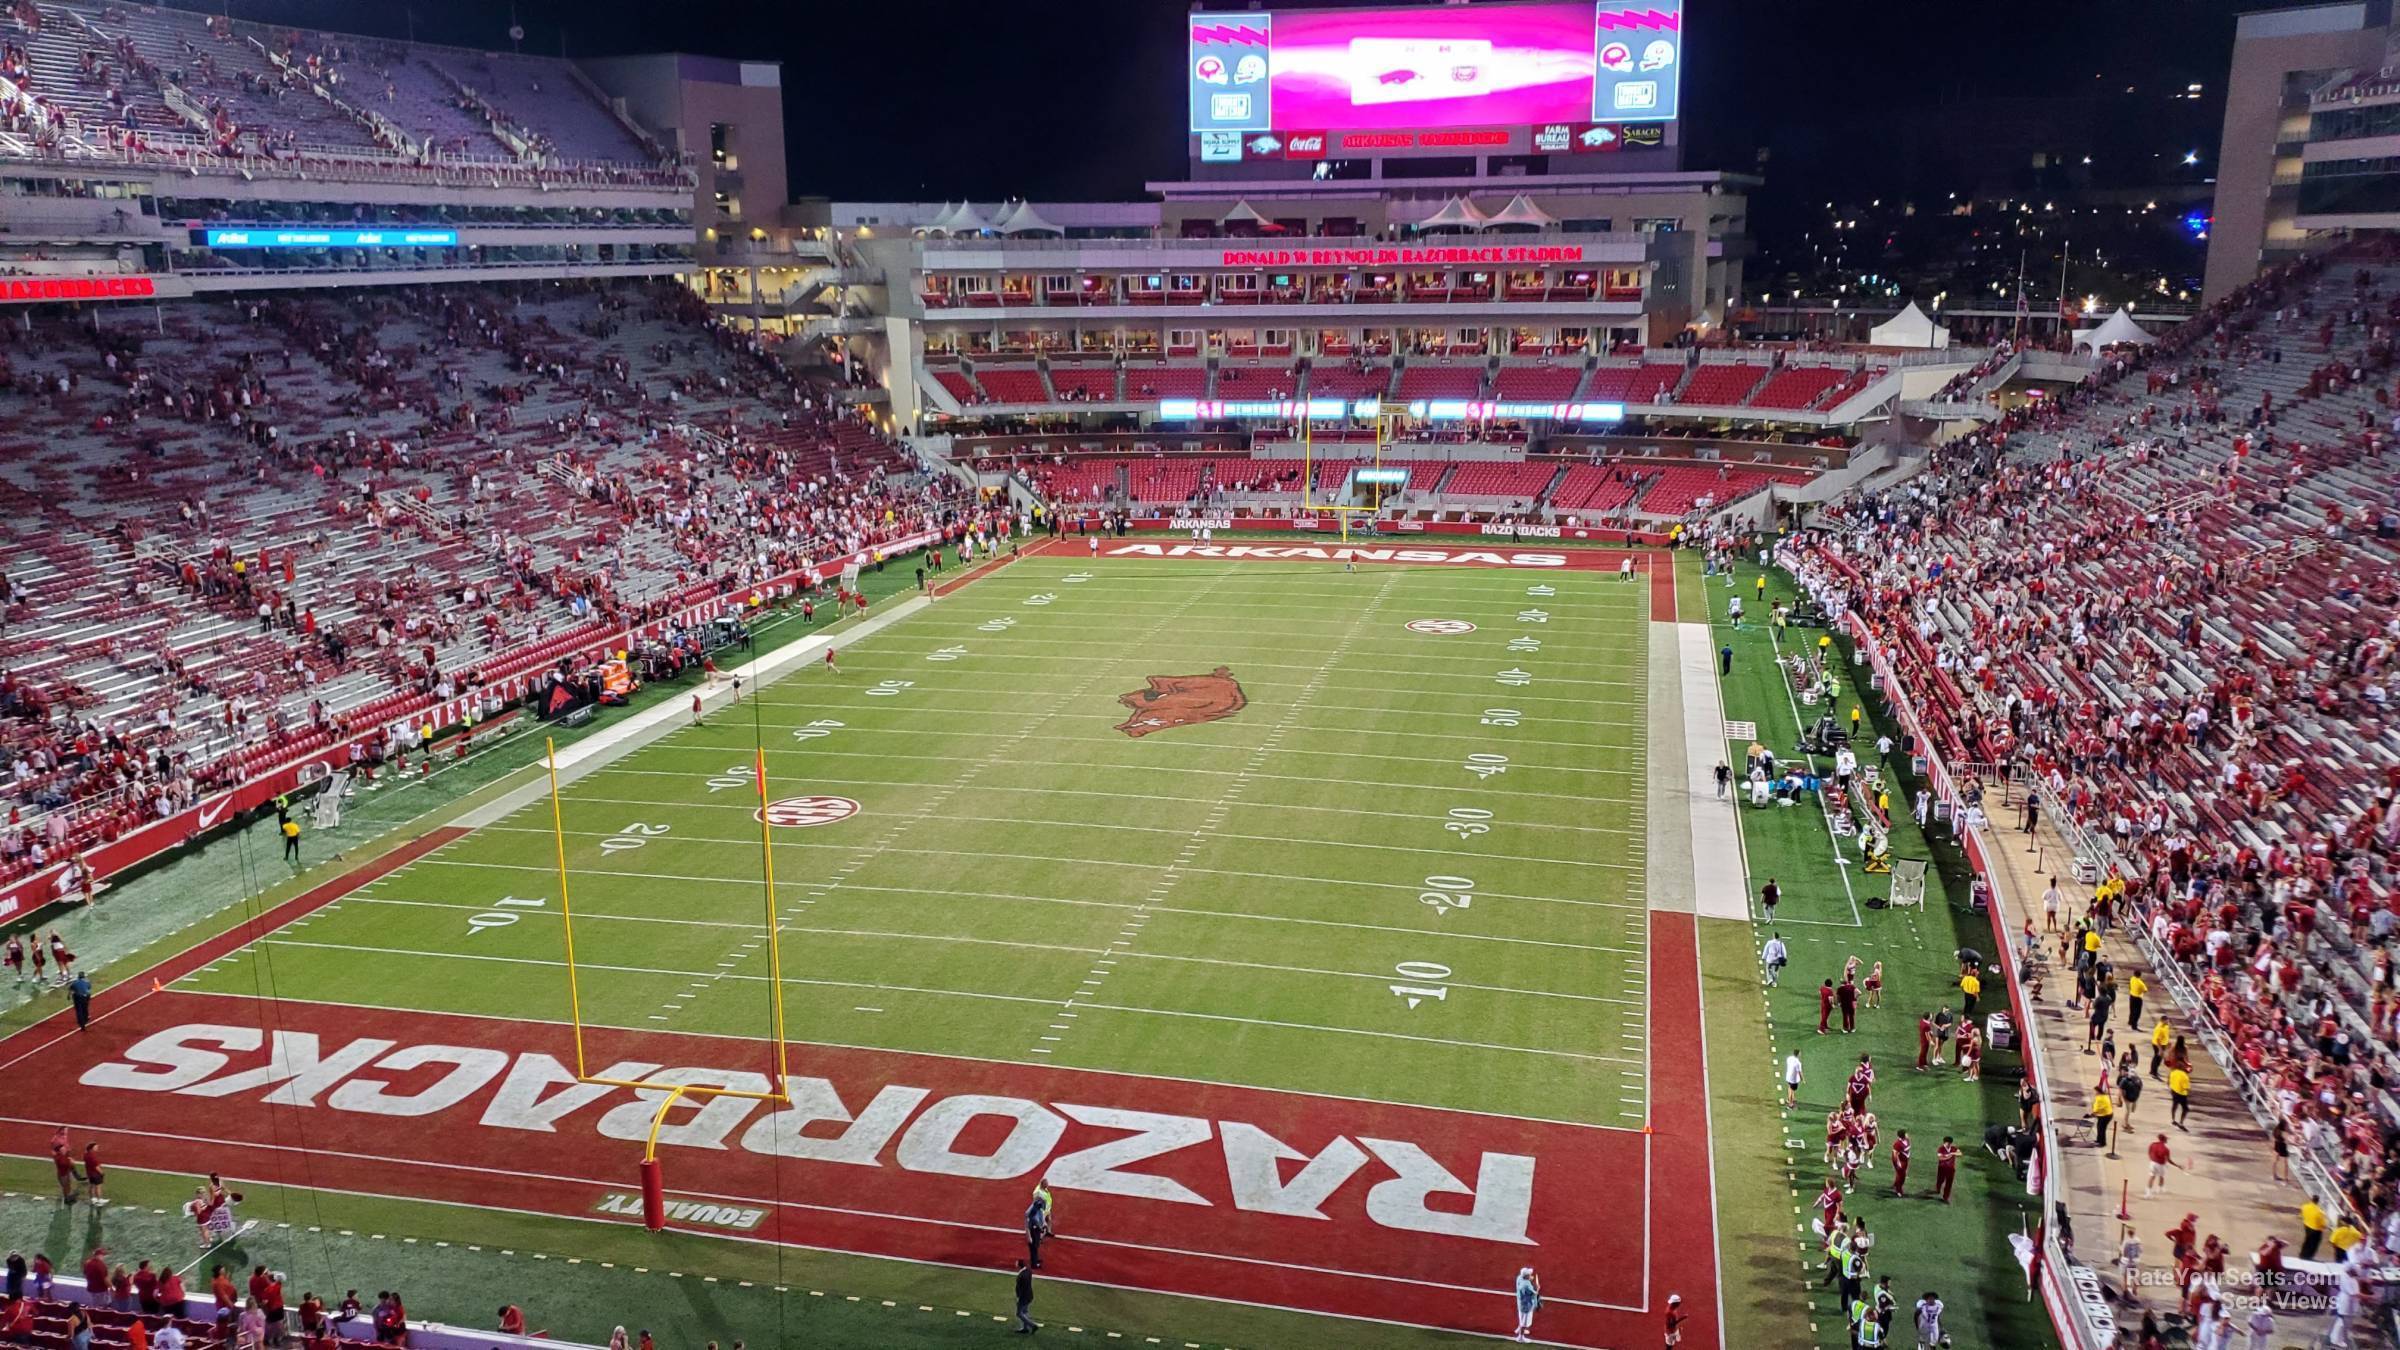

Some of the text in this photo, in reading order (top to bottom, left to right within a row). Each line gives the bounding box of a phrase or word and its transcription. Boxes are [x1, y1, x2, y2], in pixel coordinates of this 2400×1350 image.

[1536, 134, 1570, 144] BUREAU
[1545, 126, 1569, 134] FARM
[1343, 134, 1413, 147] ARKANSAS
[1224, 247, 1582, 265] DONALD W REYNOLDS RAZORBACK STADIUM
[1169, 519, 1231, 529] ARKANSAS
[1105, 544, 1567, 566] ARKANSAS
[1526, 586, 1556, 596] 10
[1516, 611, 1549, 623] 20
[1507, 638, 1541, 652] 30
[1496, 671, 1532, 686] 40
[865, 680, 915, 696] 50
[1480, 708, 1522, 726] 50
[793, 719, 845, 738] 40
[1464, 753, 1508, 775] 40
[706, 765, 767, 788] 30
[1445, 808, 1493, 834] 30
[599, 822, 670, 850] 20
[1419, 875, 1474, 909] 20
[468, 896, 547, 927] 10
[1389, 961, 1451, 1001] 10
[79, 1024, 1541, 1246] RAZORBACKS
